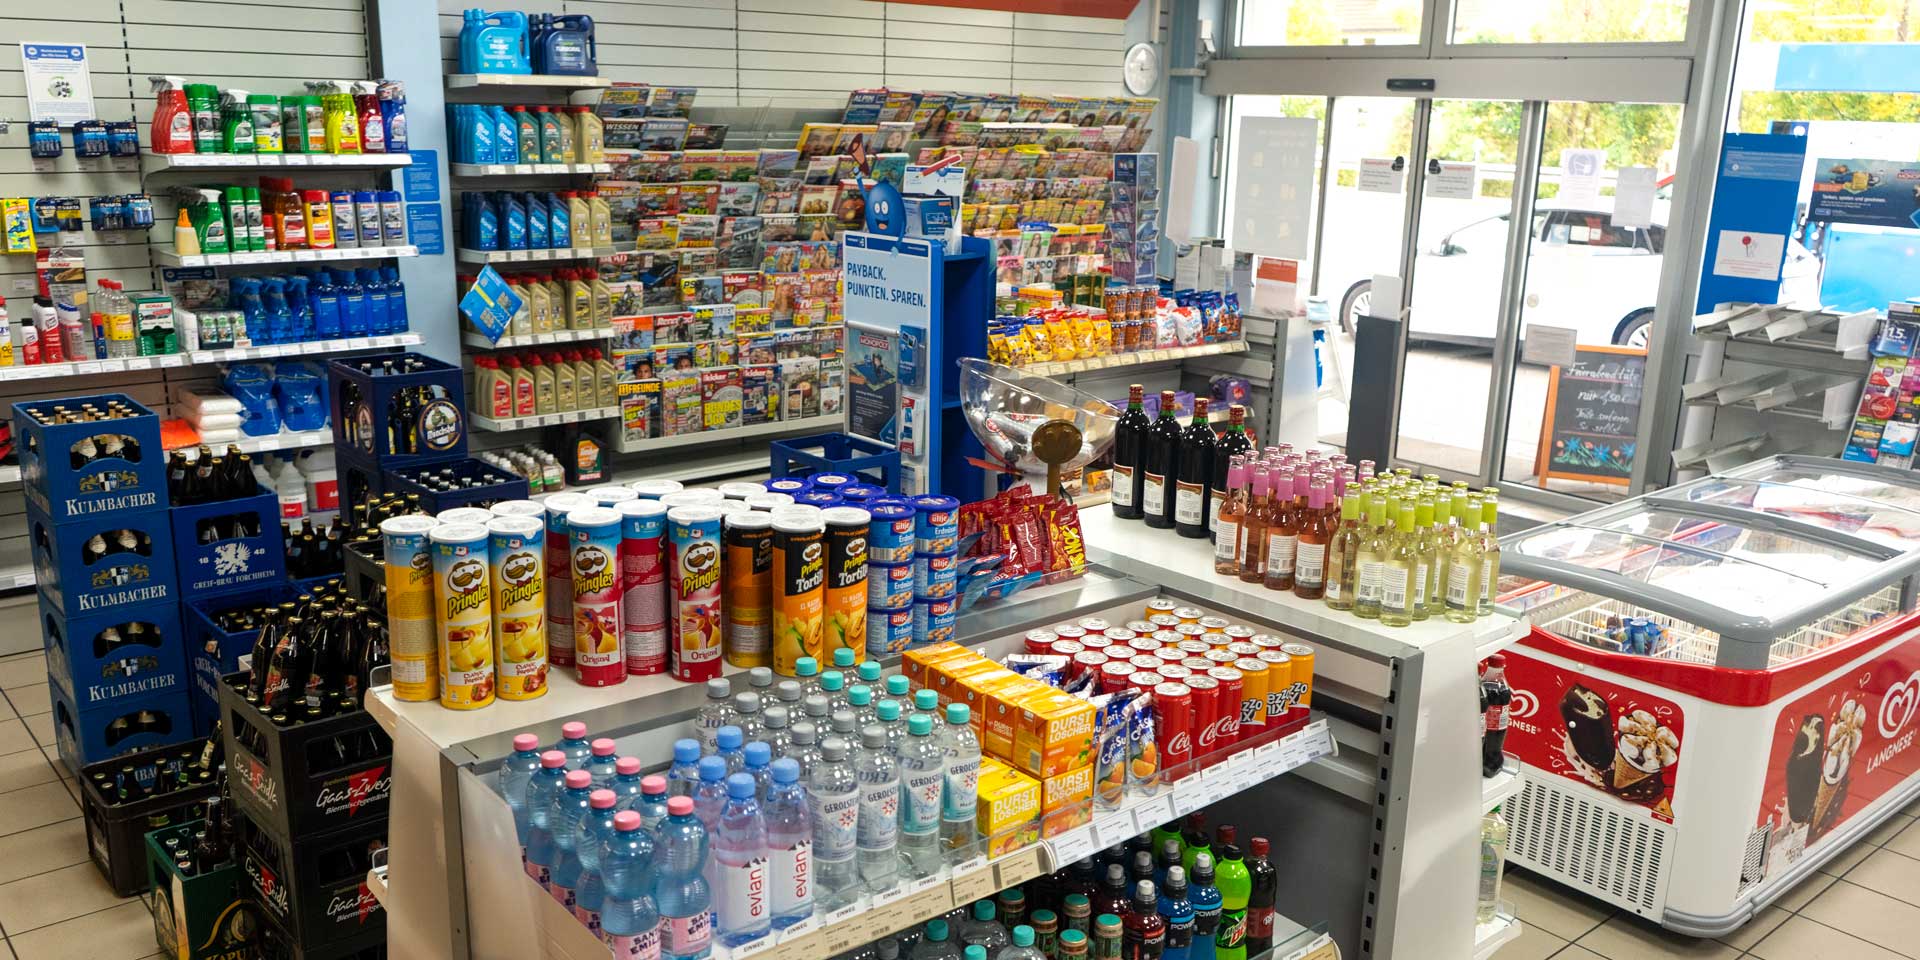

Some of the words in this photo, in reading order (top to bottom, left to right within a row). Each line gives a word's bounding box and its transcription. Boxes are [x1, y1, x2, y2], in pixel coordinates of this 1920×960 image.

[847, 262, 887, 281] PAYBACK.
[847, 281, 889, 301] PUNKTEN.
[891, 288, 927, 308] SPAREN.
[736, 313, 771, 327] E-BIKE
[860, 337, 889, 350] MONOPOLY
[704, 399, 742, 412] BUNDES
[704, 413, 726, 427] LIGA
[931, 513, 949, 524] ültje
[894, 521, 910, 531] ültje
[932, 558, 949, 569] ültje
[892, 567, 908, 577] ültje
[574, 573, 614, 596] Pringles
[448, 584, 489, 619] Pringles
[501, 578, 543, 611] Pringles
[932, 604, 949, 614] ültje
[892, 613, 909, 623] ültje
[582, 654, 610, 665] Original
[691, 648, 718, 661] Original
[1050, 710, 1093, 734] DURST
[1866, 733, 1914, 774] LANGNESE
[1048, 769, 1091, 791] DURST
[993, 788, 1037, 812] DURST
[792, 850, 807, 898] evian
[748, 867, 763, 917] evian
